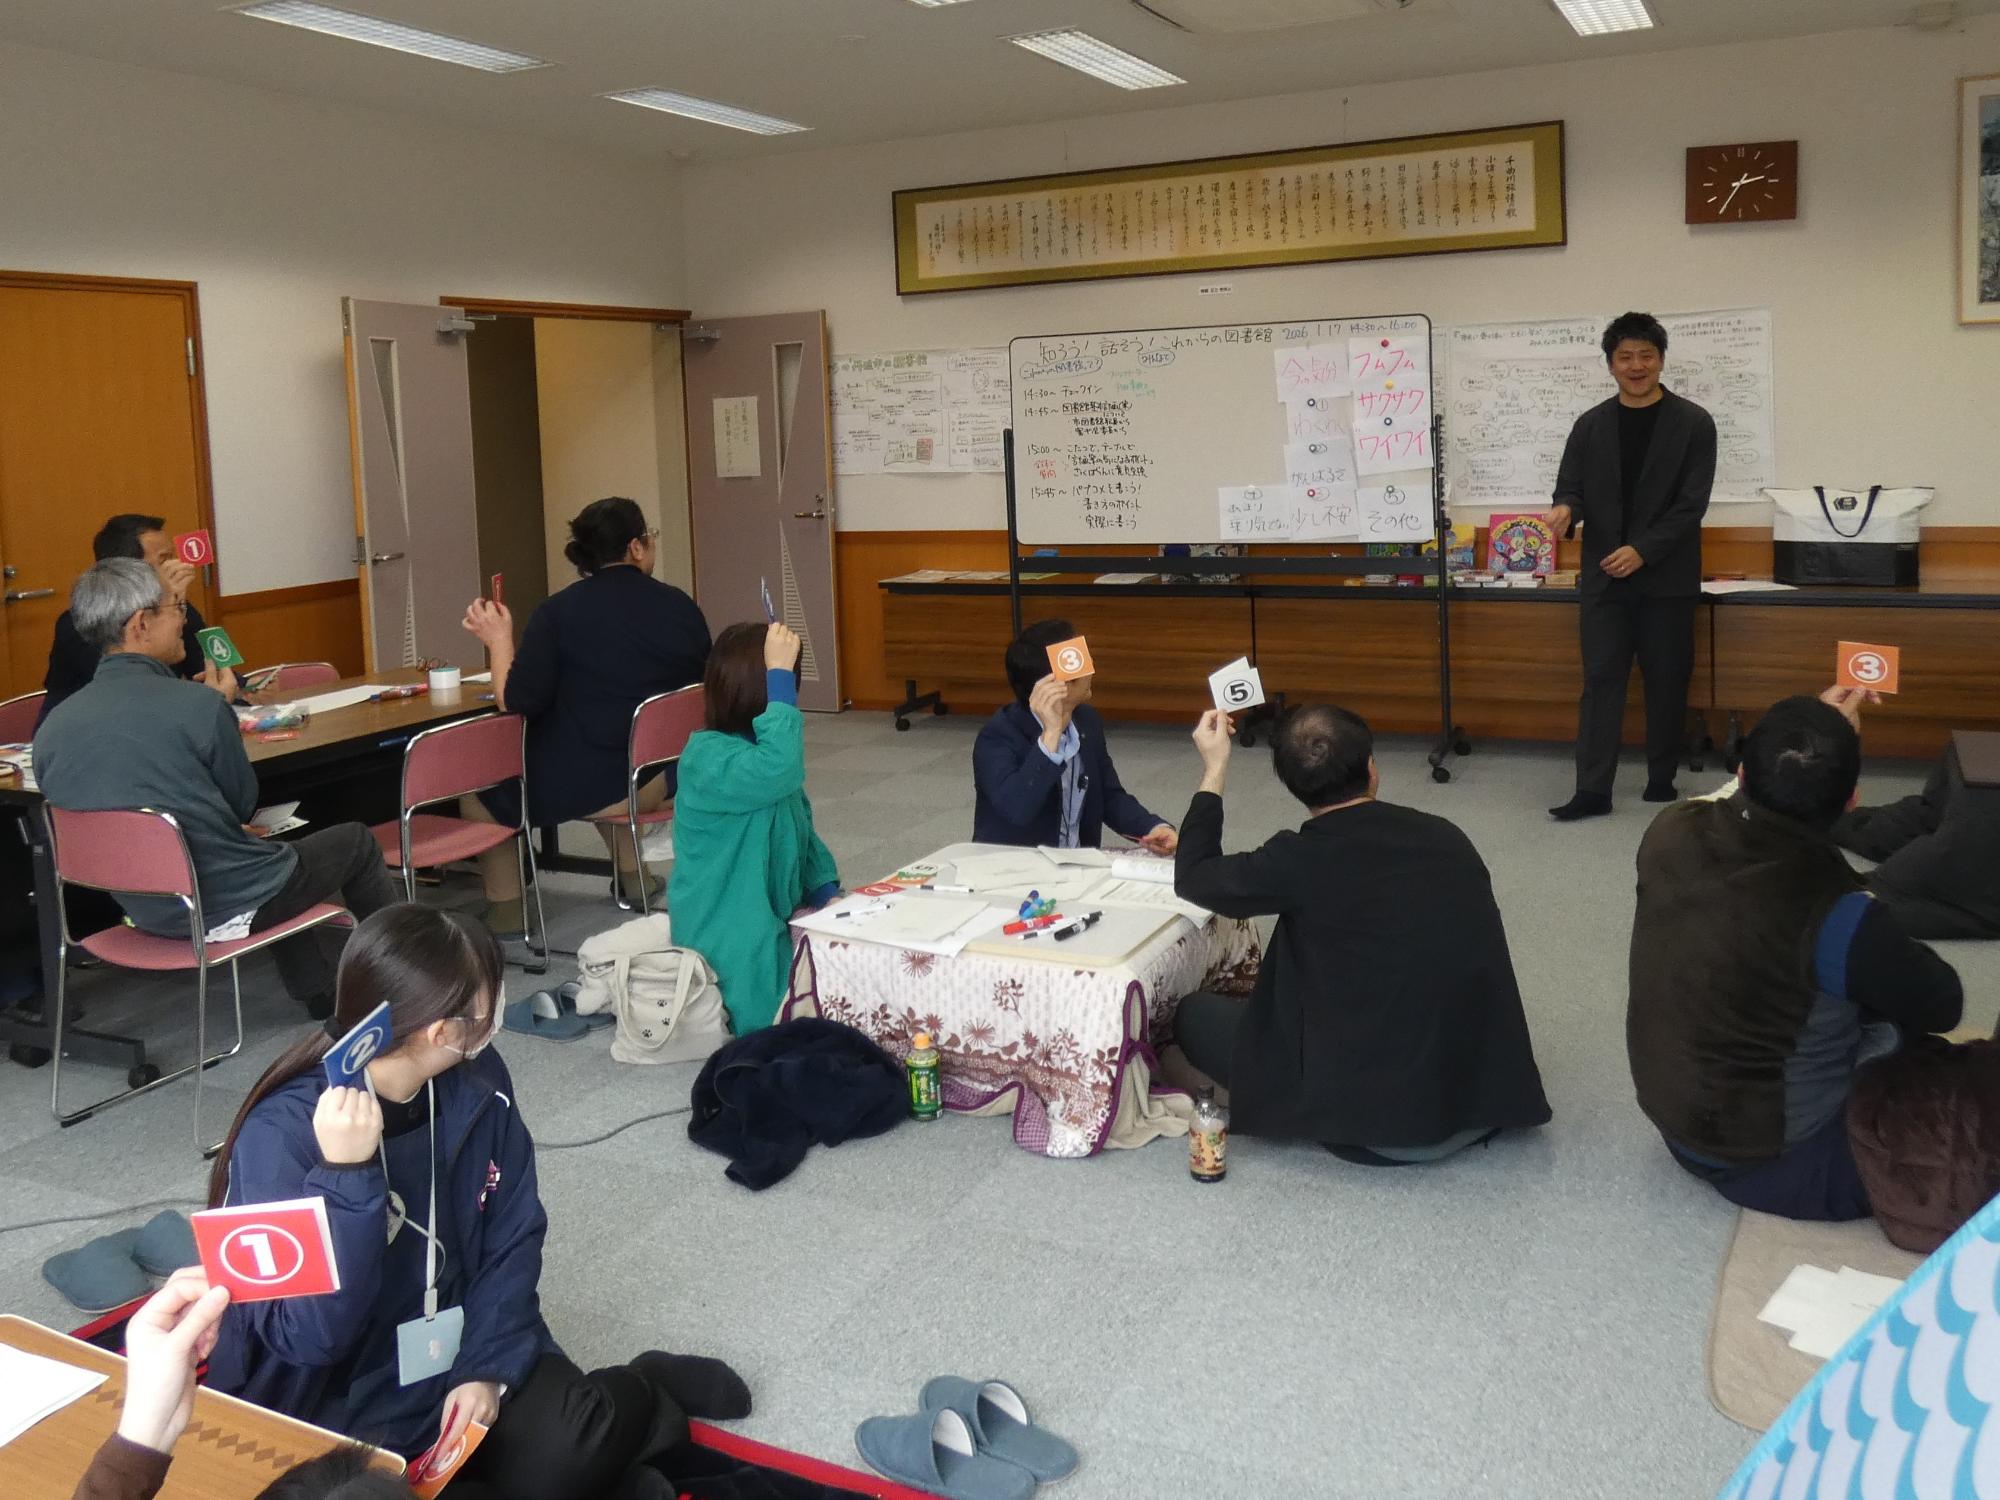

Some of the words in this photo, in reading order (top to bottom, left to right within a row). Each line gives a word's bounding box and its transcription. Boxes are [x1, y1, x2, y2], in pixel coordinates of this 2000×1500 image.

[1161, 328, 1273, 350] これからの図書館
[1354, 350, 1415, 378] フムフム
[1359, 430, 1426, 460] ワイワイ
[1367, 511, 1423, 534] その他
